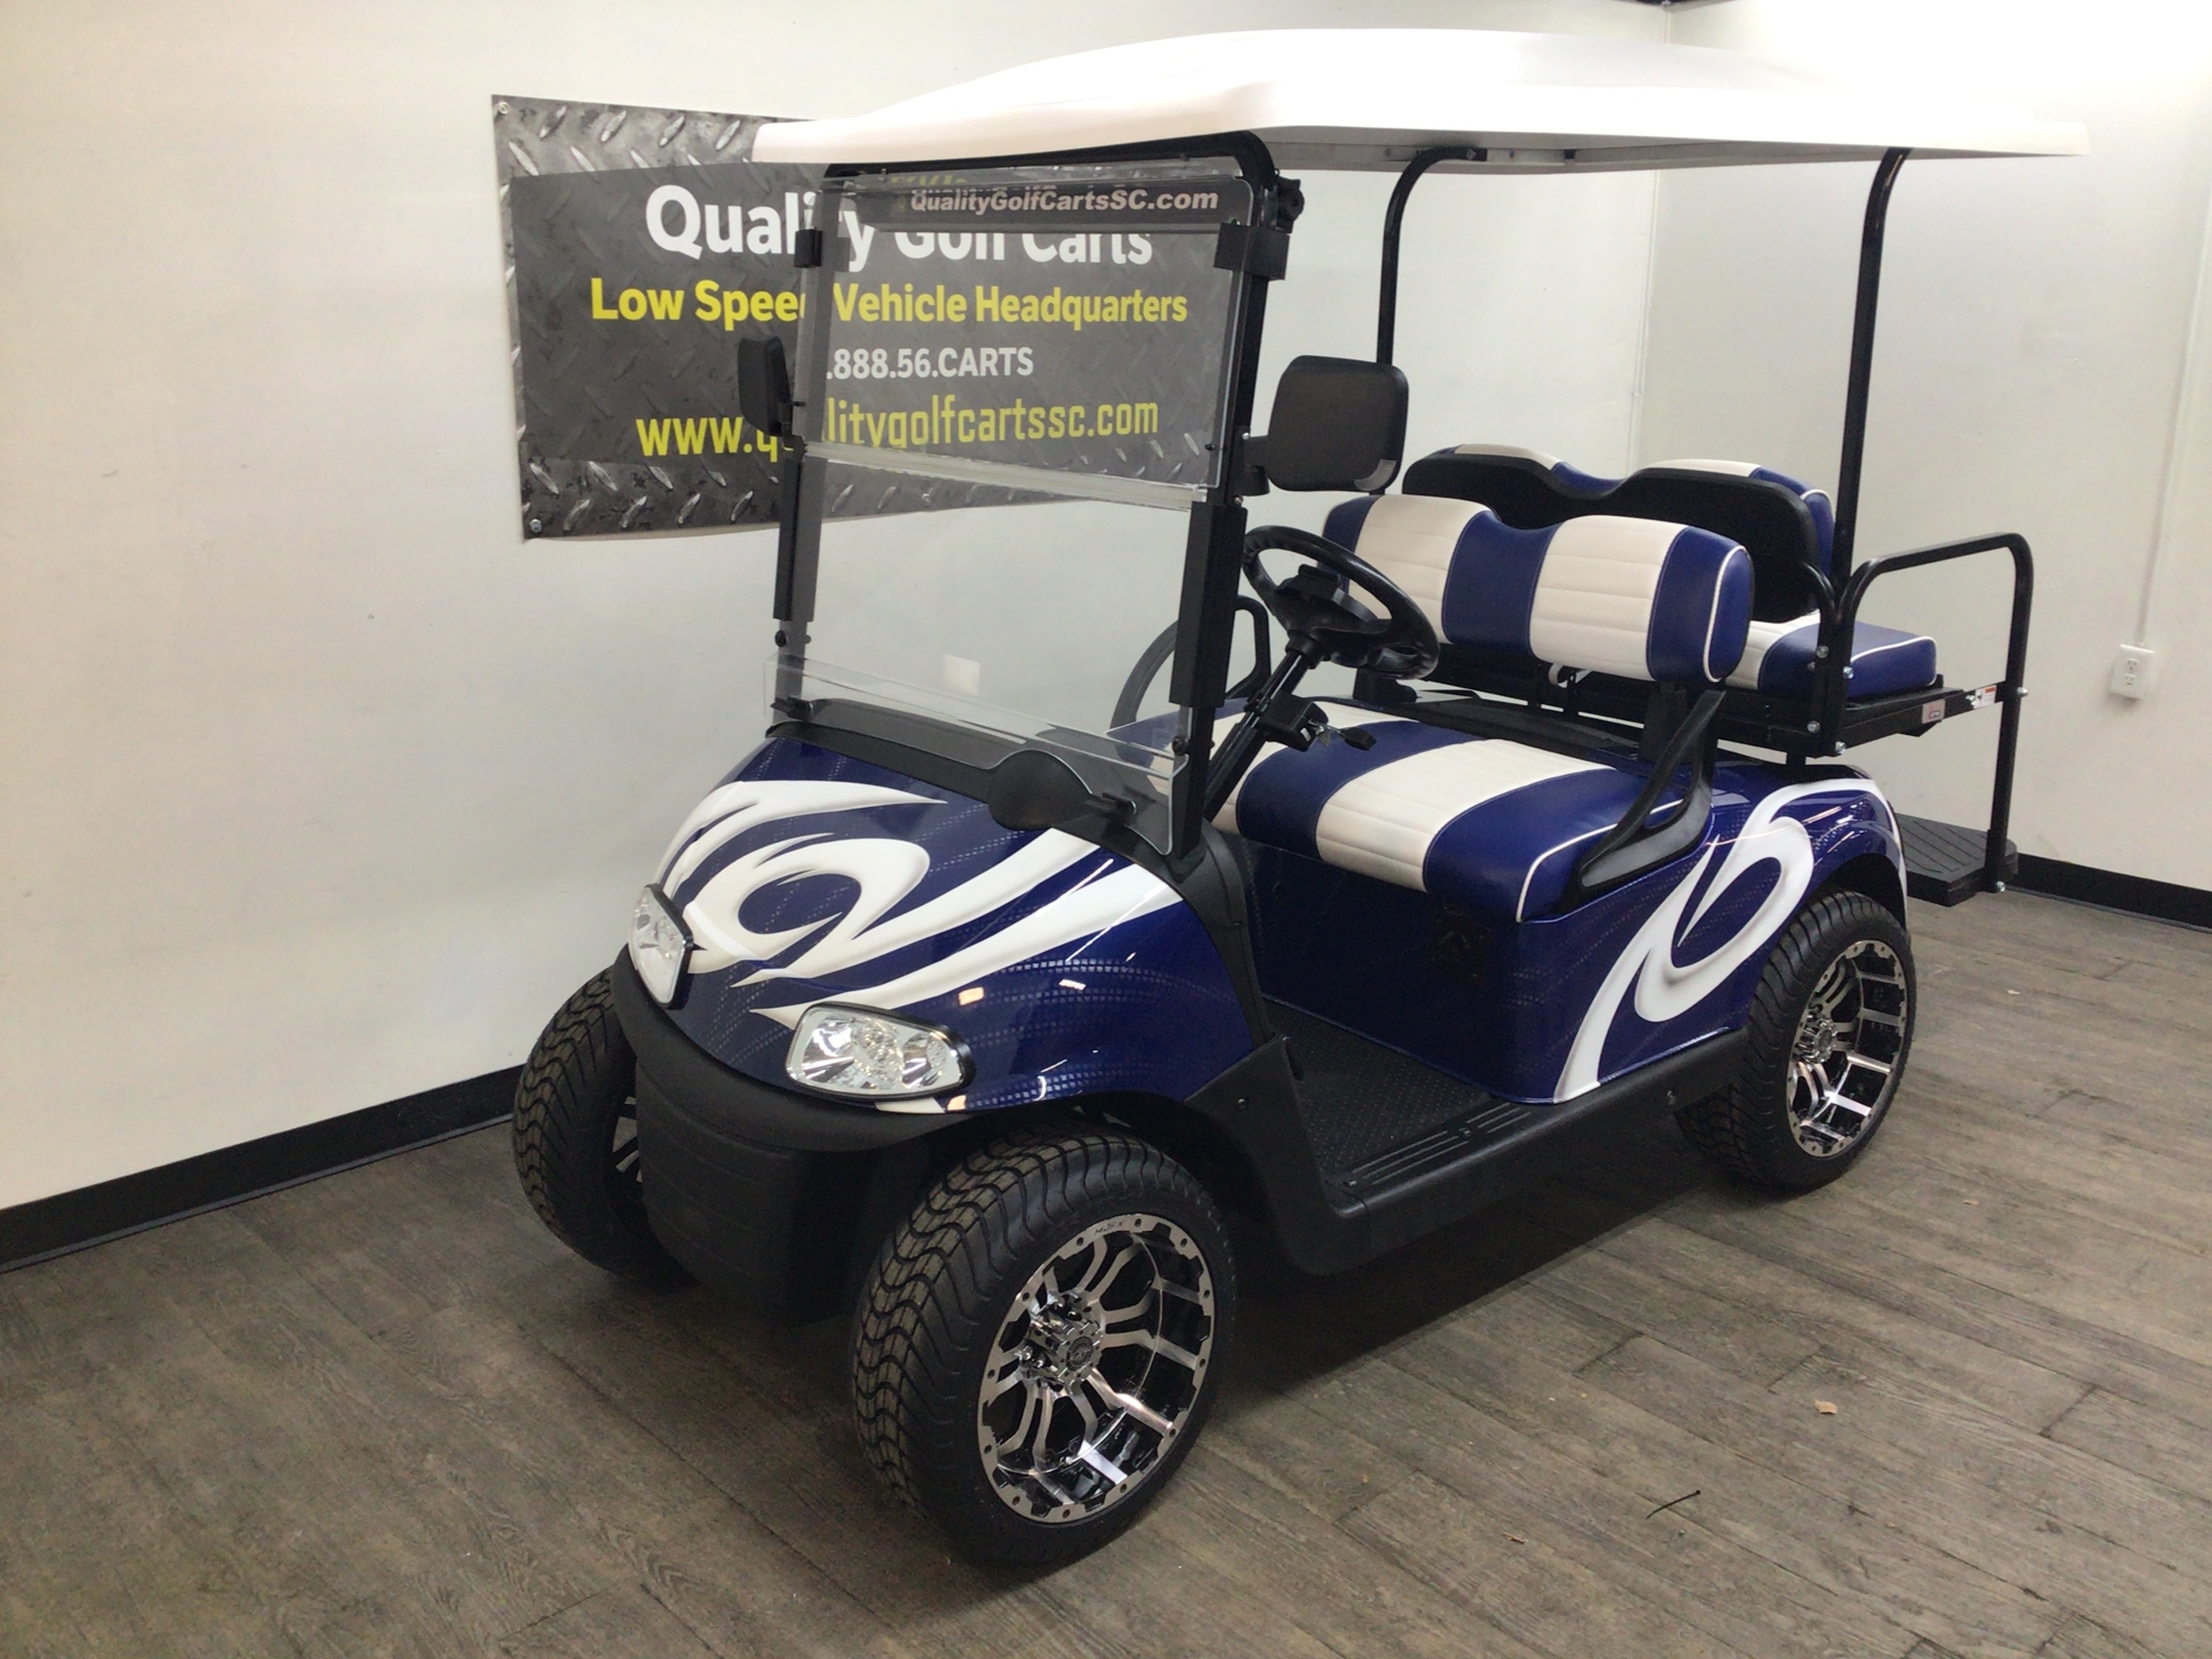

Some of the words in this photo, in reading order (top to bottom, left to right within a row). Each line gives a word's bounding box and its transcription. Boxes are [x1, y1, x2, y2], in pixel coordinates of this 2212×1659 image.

[645, 184, 875, 272] Qualiy
[911, 188, 1219, 216] QualityGolfCartsSC.com
[591, 277, 685, 321] Low
[694, 279, 806, 331] Spee
[833, 283, 967, 323] Vehicle
[975, 285, 1189, 331] Headquarters
[825, 346, 1034, 379] .888.56.CARTS
[635, 394, 1159, 463] www.qlitygolfcartssc.com
